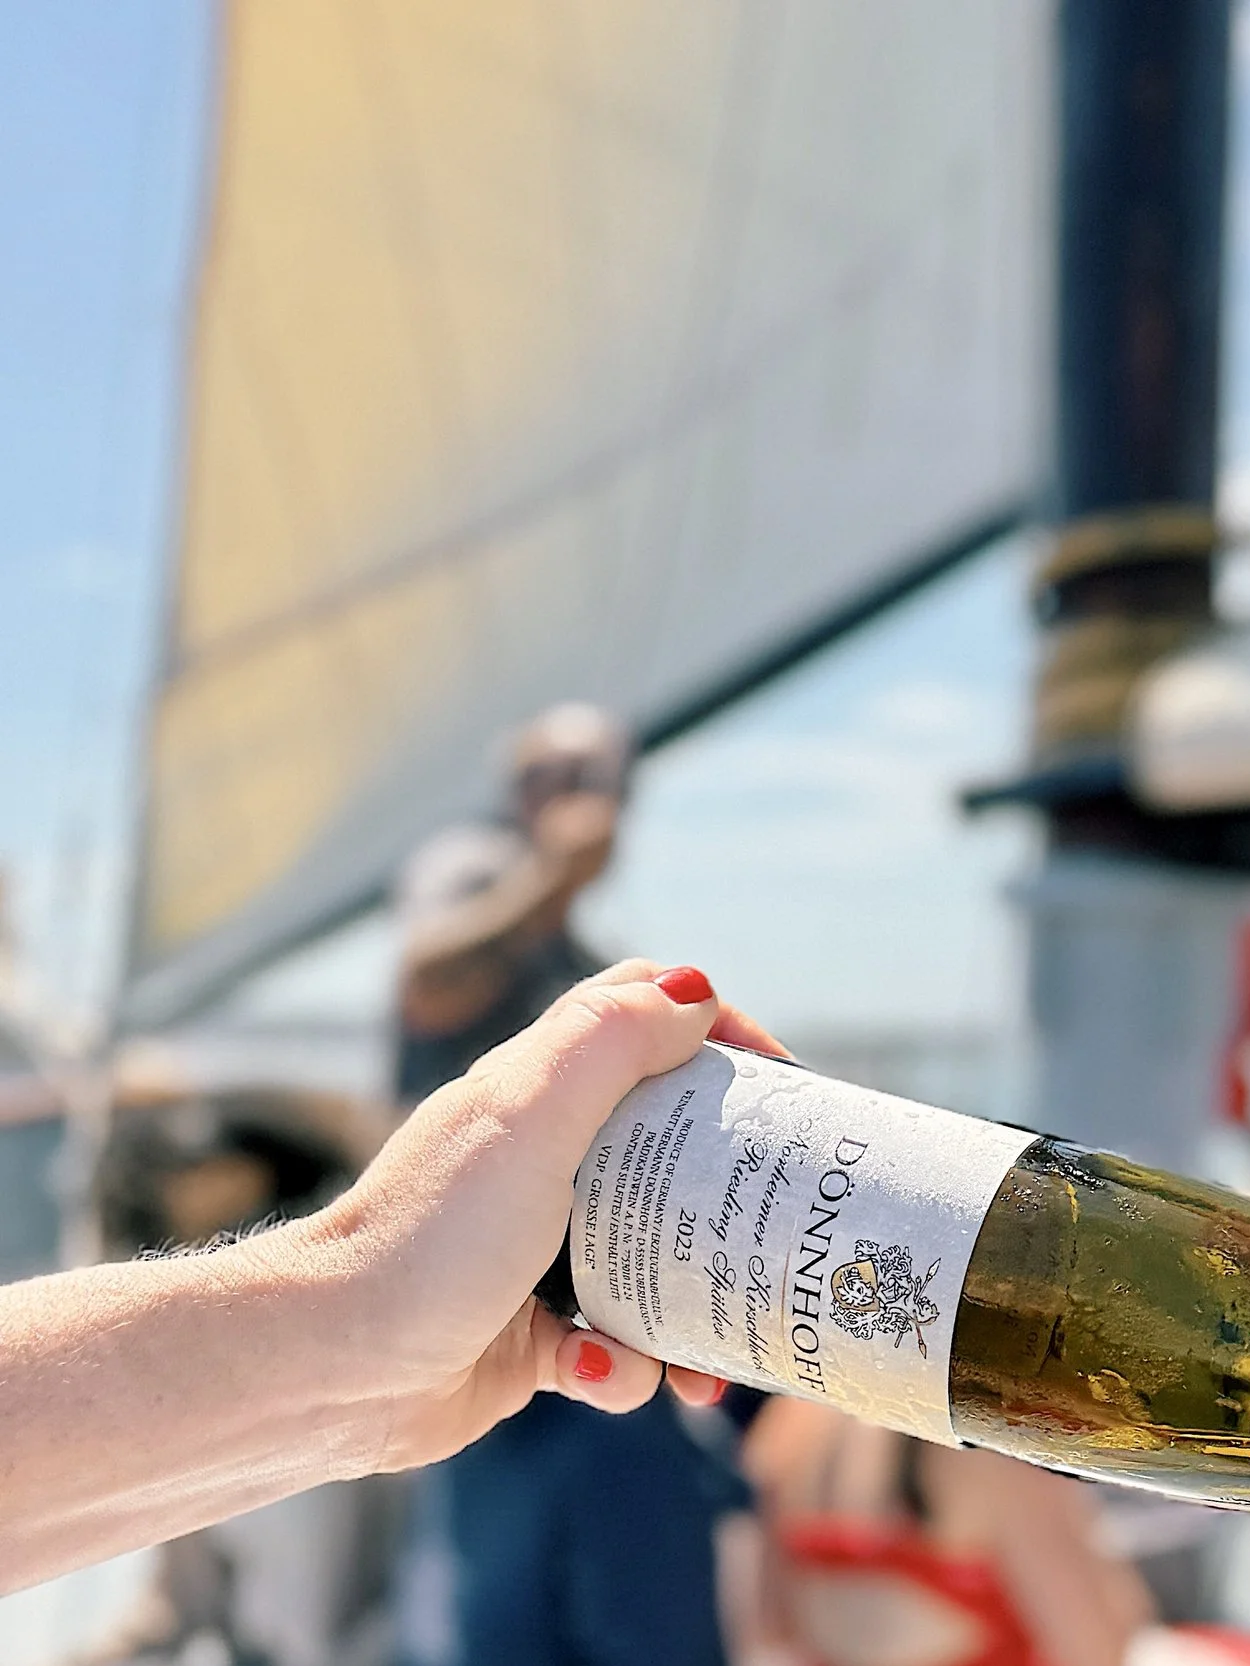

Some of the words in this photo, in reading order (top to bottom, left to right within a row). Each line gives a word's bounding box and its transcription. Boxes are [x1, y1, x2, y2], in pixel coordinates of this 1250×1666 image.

[668, 1090, 695, 1127] WEINGUT
[621, 1123, 644, 1171] CONTAINS
[650, 1127, 674, 1176] HERMANN
[669, 1119, 694, 1162] PRODUCE
[612, 1172, 627, 1216] SULFITES
[665, 1163, 675, 1177] OF
[708, 1138, 768, 1242] Riesling
[754, 1116, 814, 1247] Norheimer
[586, 1179, 602, 1230] GROSSE
[654, 1178, 671, 1226] GERMANY
[674, 1207, 696, 1261] 2023
[792, 1135, 869, 1392] DÖNNHOFF
[704, 1251, 736, 1340] Spätlese
